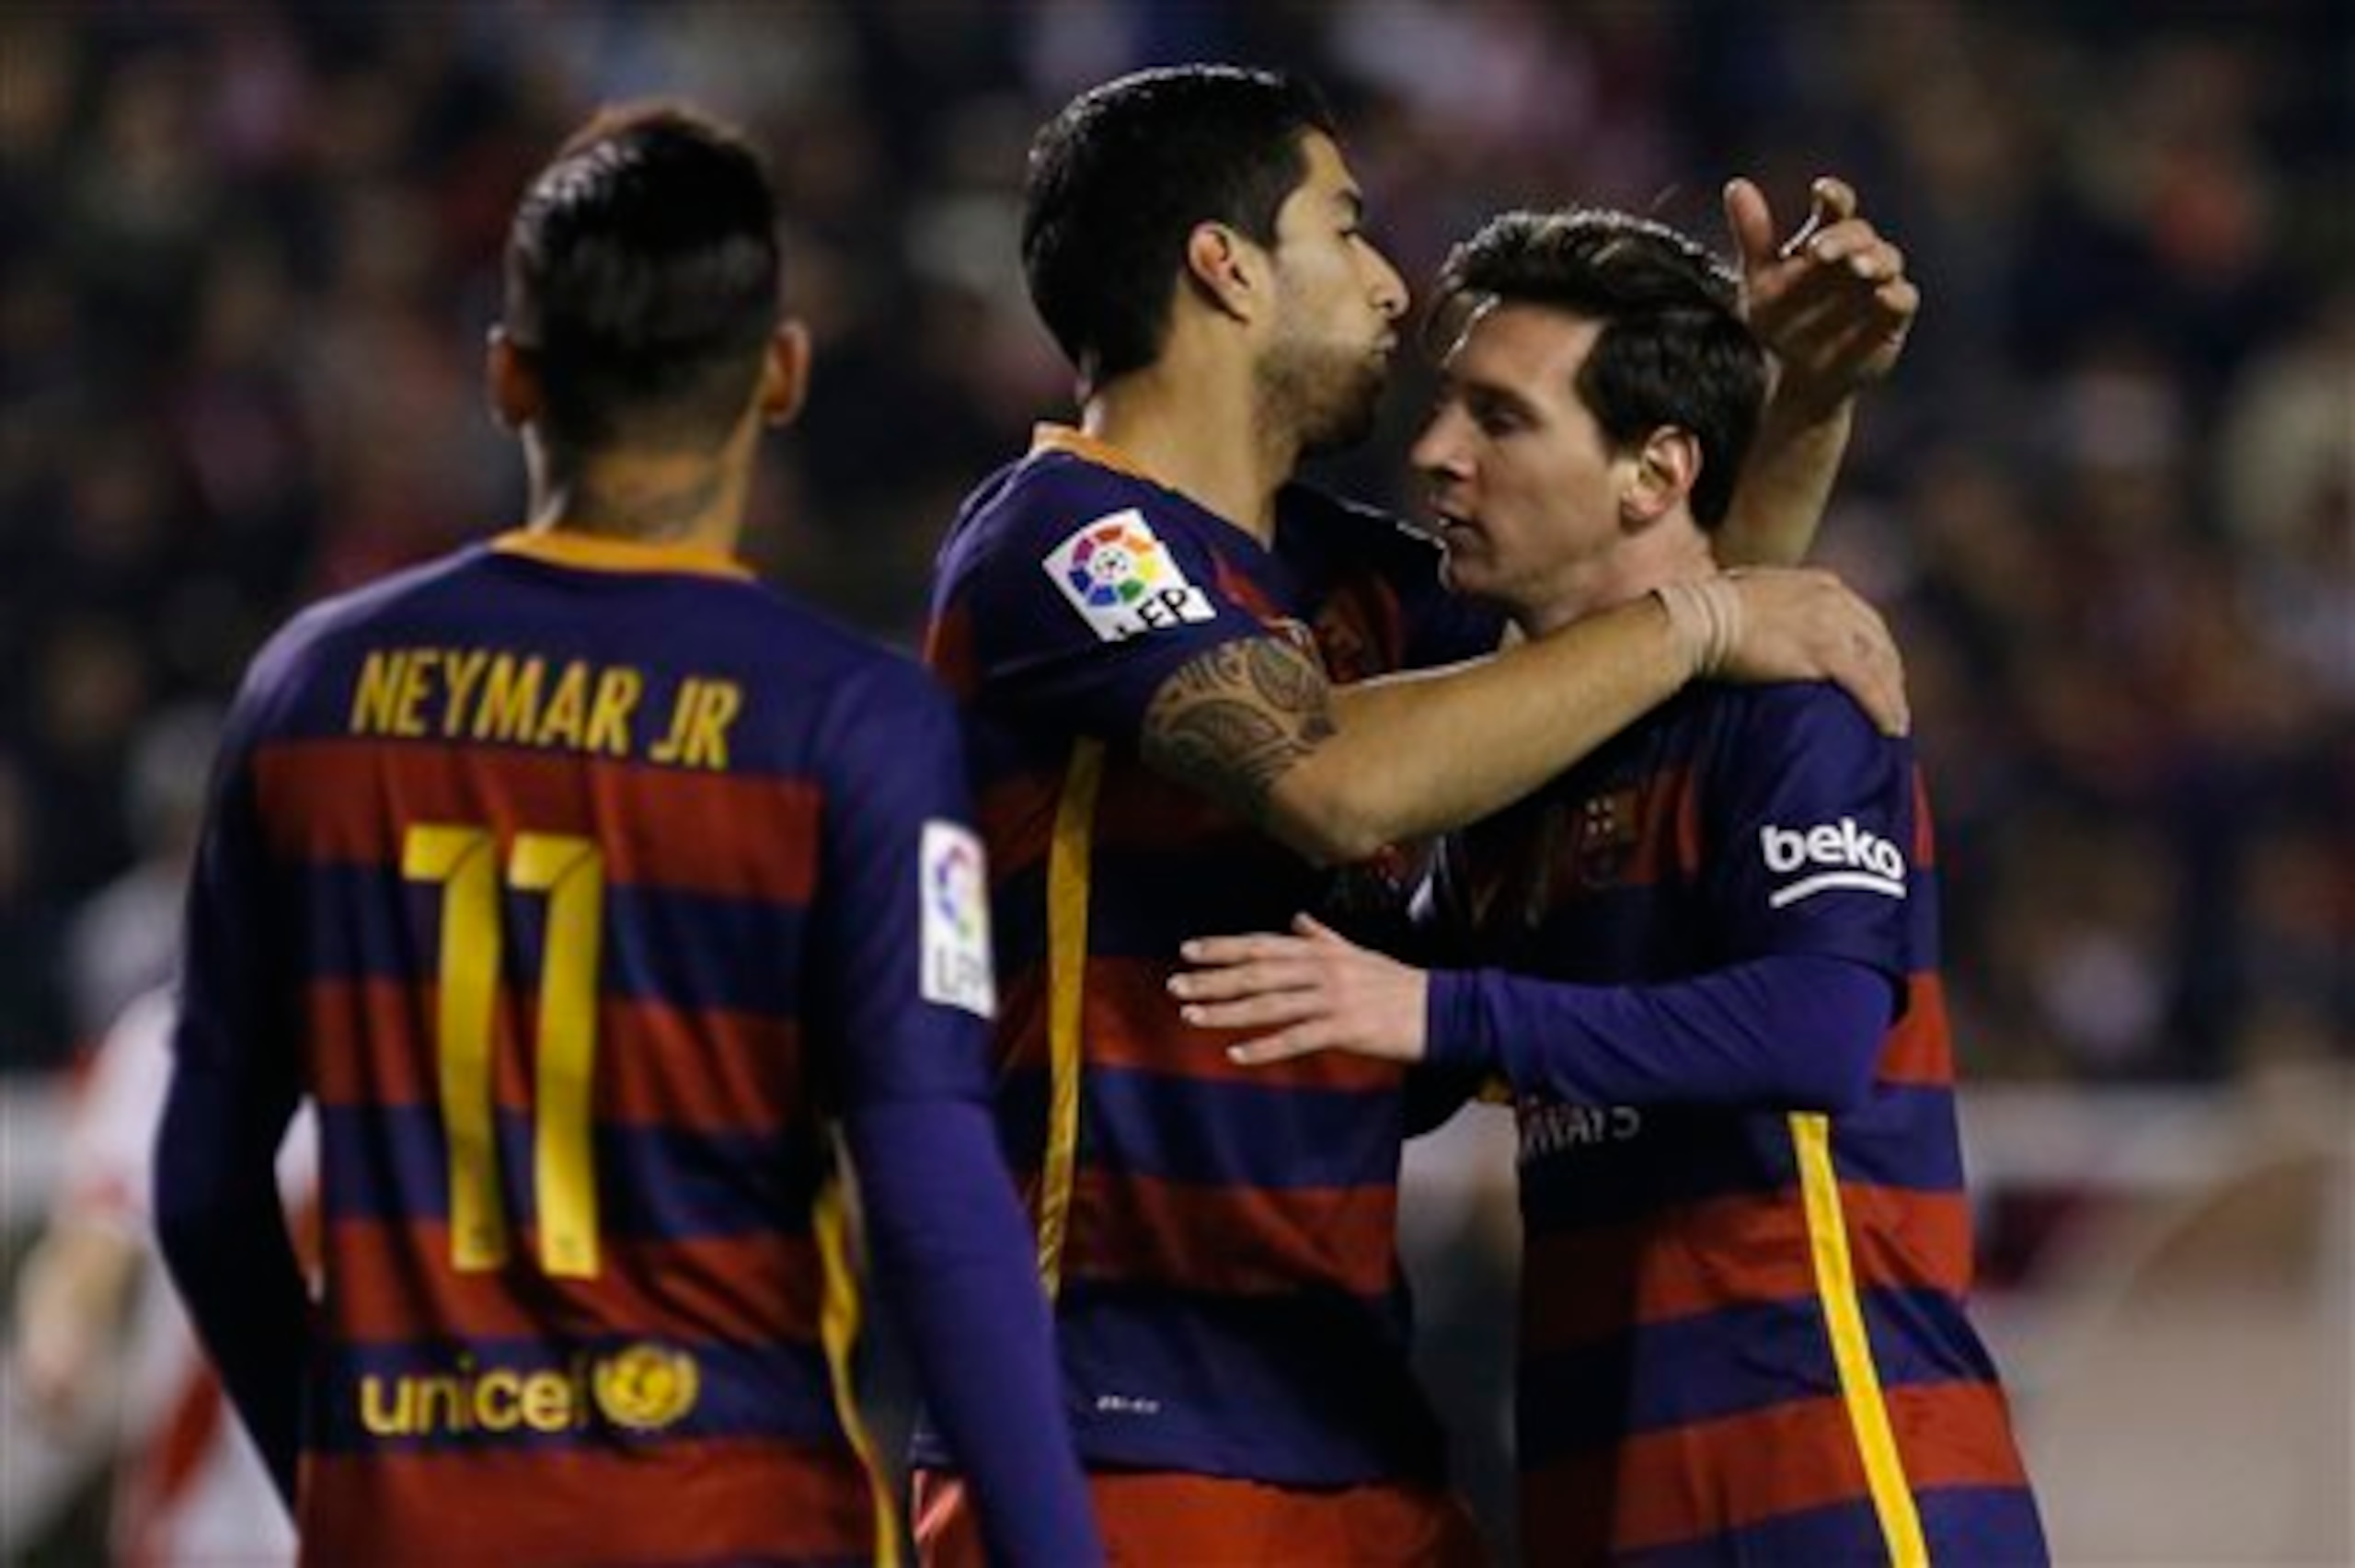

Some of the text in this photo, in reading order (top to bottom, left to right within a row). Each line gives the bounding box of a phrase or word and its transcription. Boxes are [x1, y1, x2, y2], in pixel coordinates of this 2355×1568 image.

[351, 649, 741, 772] NEYMAR JR
[1761, 816, 1905, 881] beko
[404, 824, 603, 1279] 11
